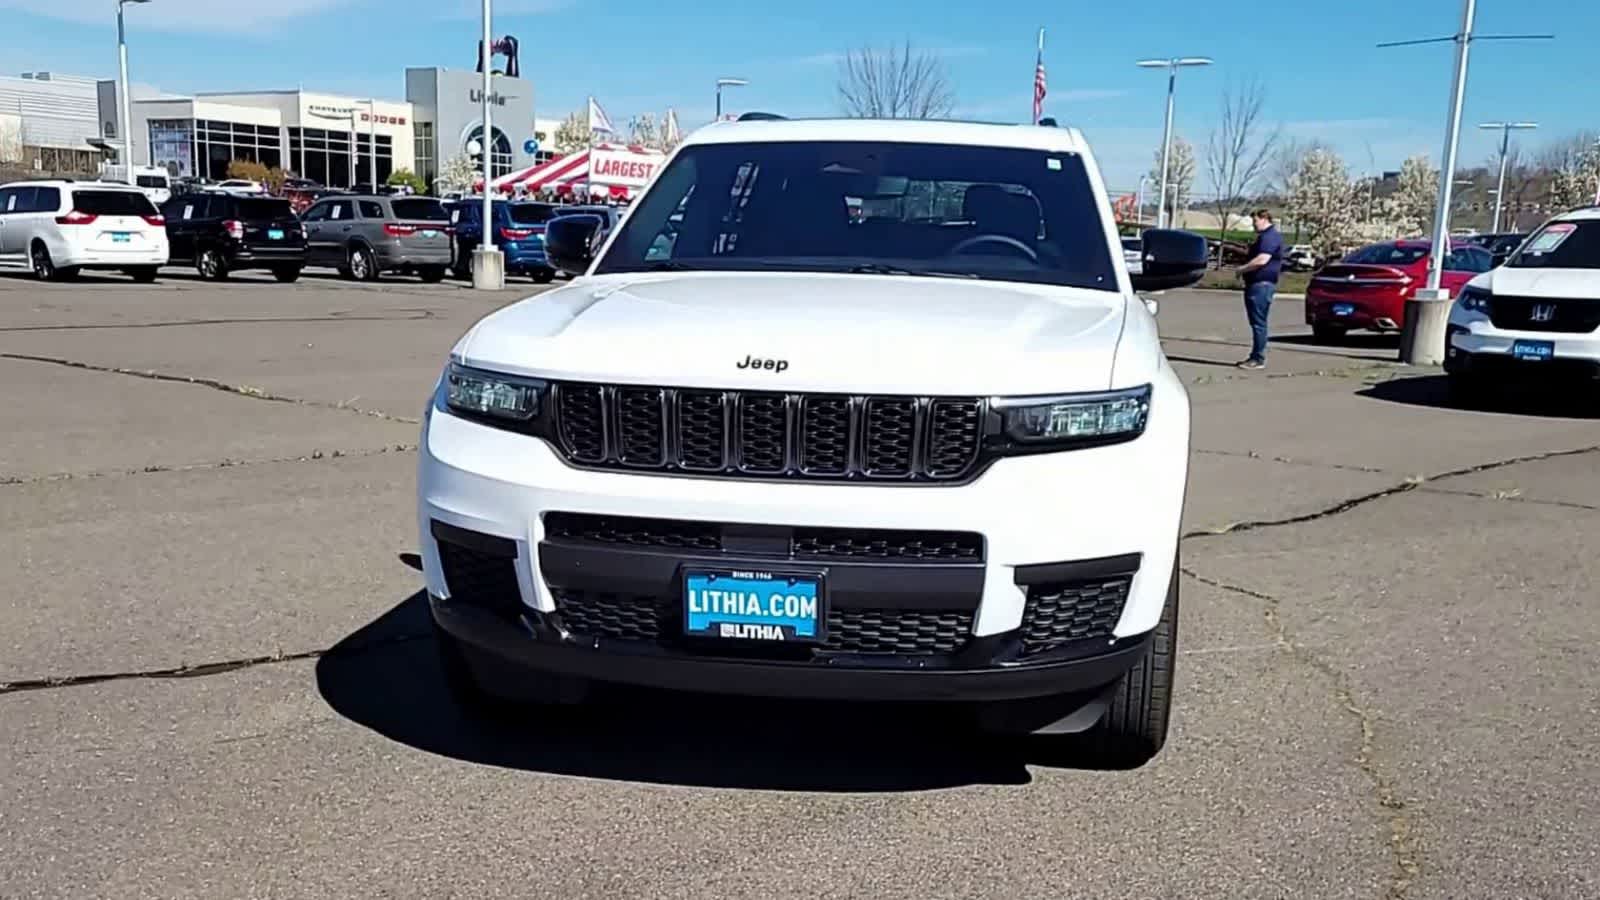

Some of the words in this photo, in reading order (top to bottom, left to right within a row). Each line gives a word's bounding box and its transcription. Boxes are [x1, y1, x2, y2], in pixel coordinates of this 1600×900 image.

[594, 157, 654, 178] LARGEST
[736, 354, 789, 373] Jeep
[732, 571, 754, 579] SINCE
[688, 589, 817, 619] LITHIA.COM
[735, 624, 784, 640] LITHIA
